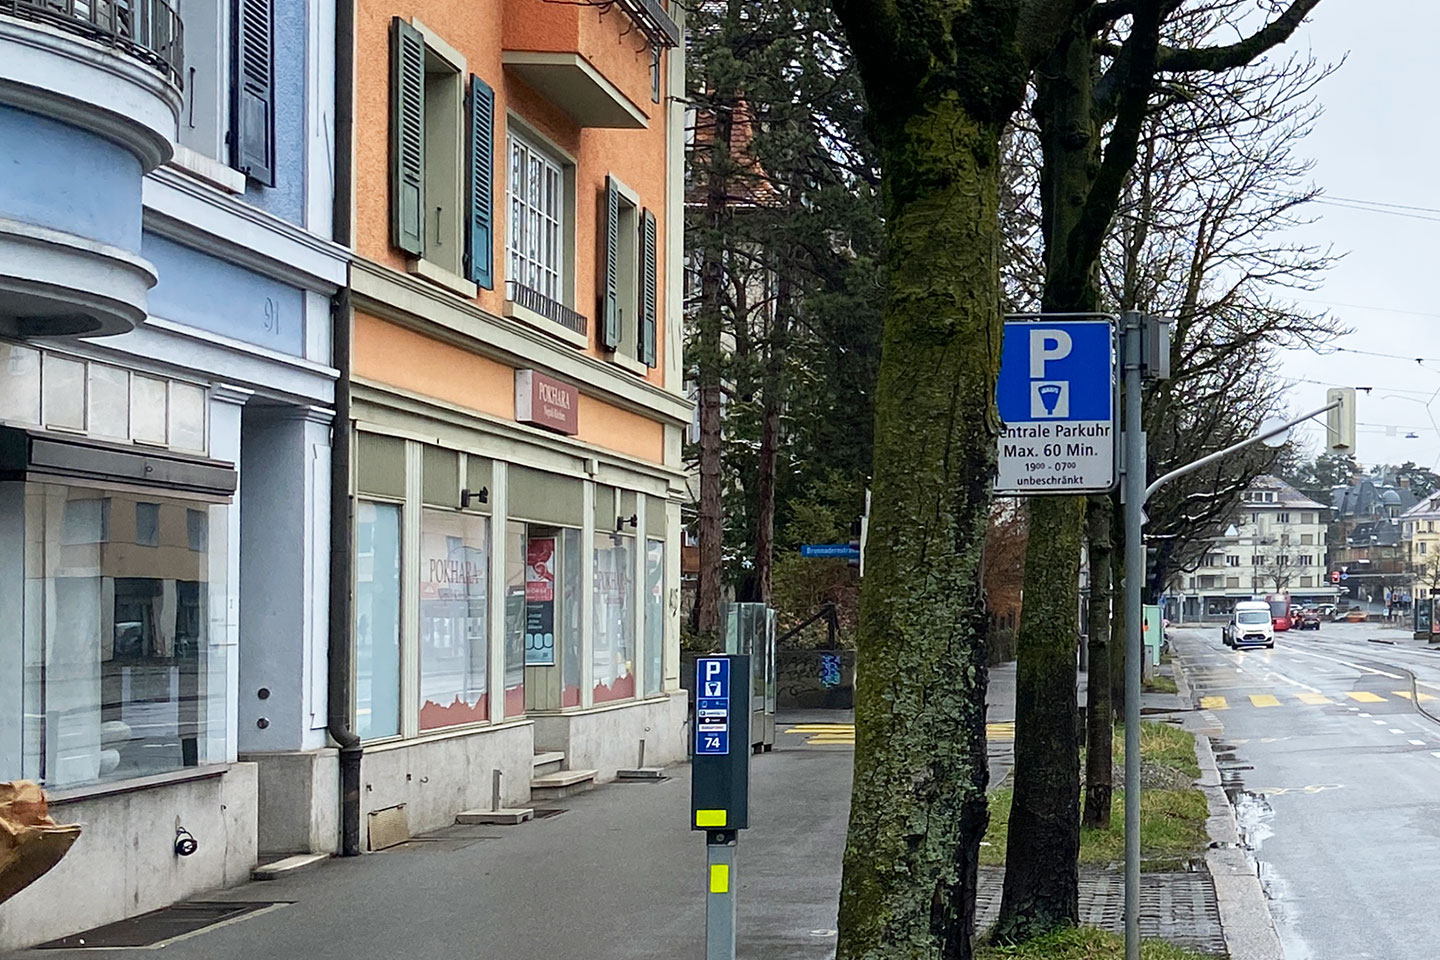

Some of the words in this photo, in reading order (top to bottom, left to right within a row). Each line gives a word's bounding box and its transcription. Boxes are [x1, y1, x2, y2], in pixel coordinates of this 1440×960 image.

[1029, 328, 1073, 379] P
[538, 381, 571, 410] POKHARA
[999, 423, 1050, 439] entrale
[1055, 423, 1111, 438] Parkuhr
[1003, 444, 1039, 458] Max.
[1043, 443, 1062, 457] 60
[1066, 442, 1098, 456] Min.
[1016, 475, 1084, 486] unbeschränkt
[429, 558, 480, 584] POKHARA
[706, 661, 721, 682] P
[704, 736, 721, 749] 74
